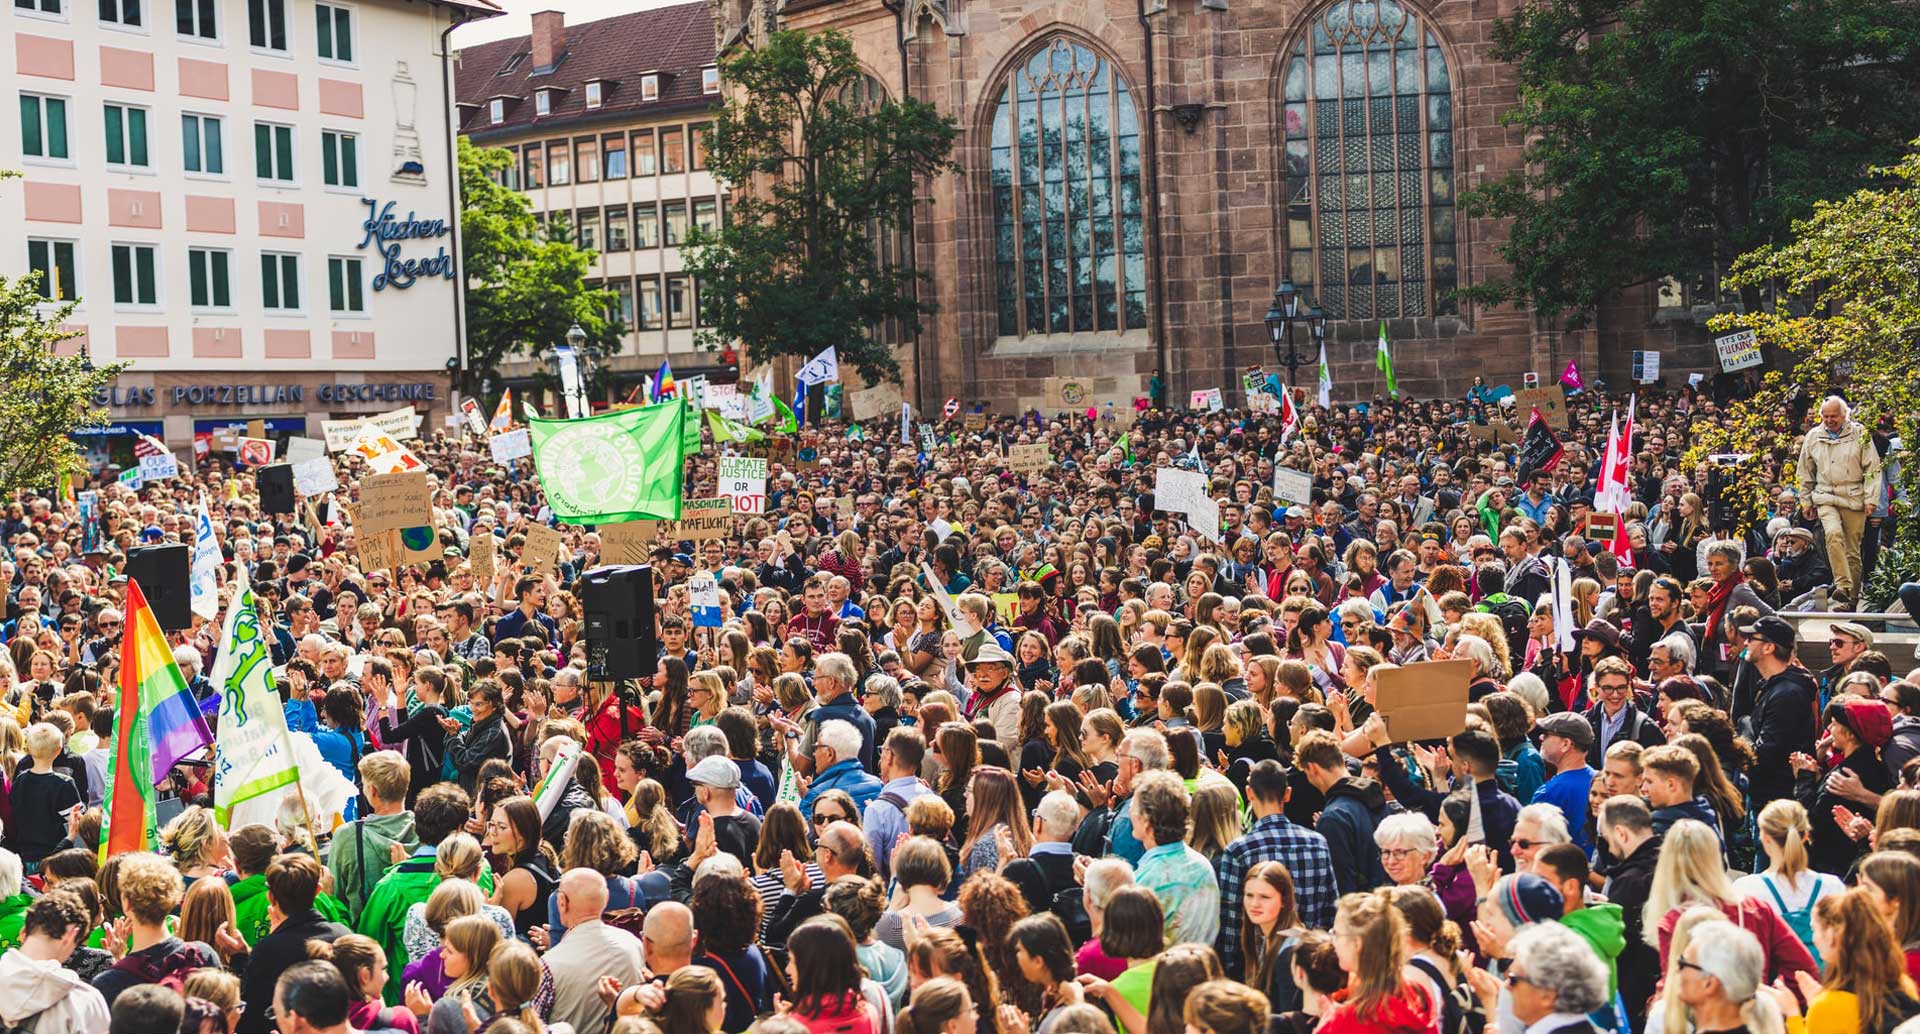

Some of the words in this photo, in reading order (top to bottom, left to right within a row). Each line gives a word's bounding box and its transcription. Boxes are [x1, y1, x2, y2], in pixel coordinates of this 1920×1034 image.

[373, 243, 457, 292] Loesch
[94, 385, 155, 407] GLAS
[172, 384, 303, 407] PORZELLAN
[317, 383, 434, 403] GESCHENKE
[146, 456, 167, 468] OUR
[720, 458, 766, 470] CLIMATE
[142, 465, 175, 479] FUTURE
[720, 467, 766, 480] JUSTICE
[734, 482, 749, 492] OR
